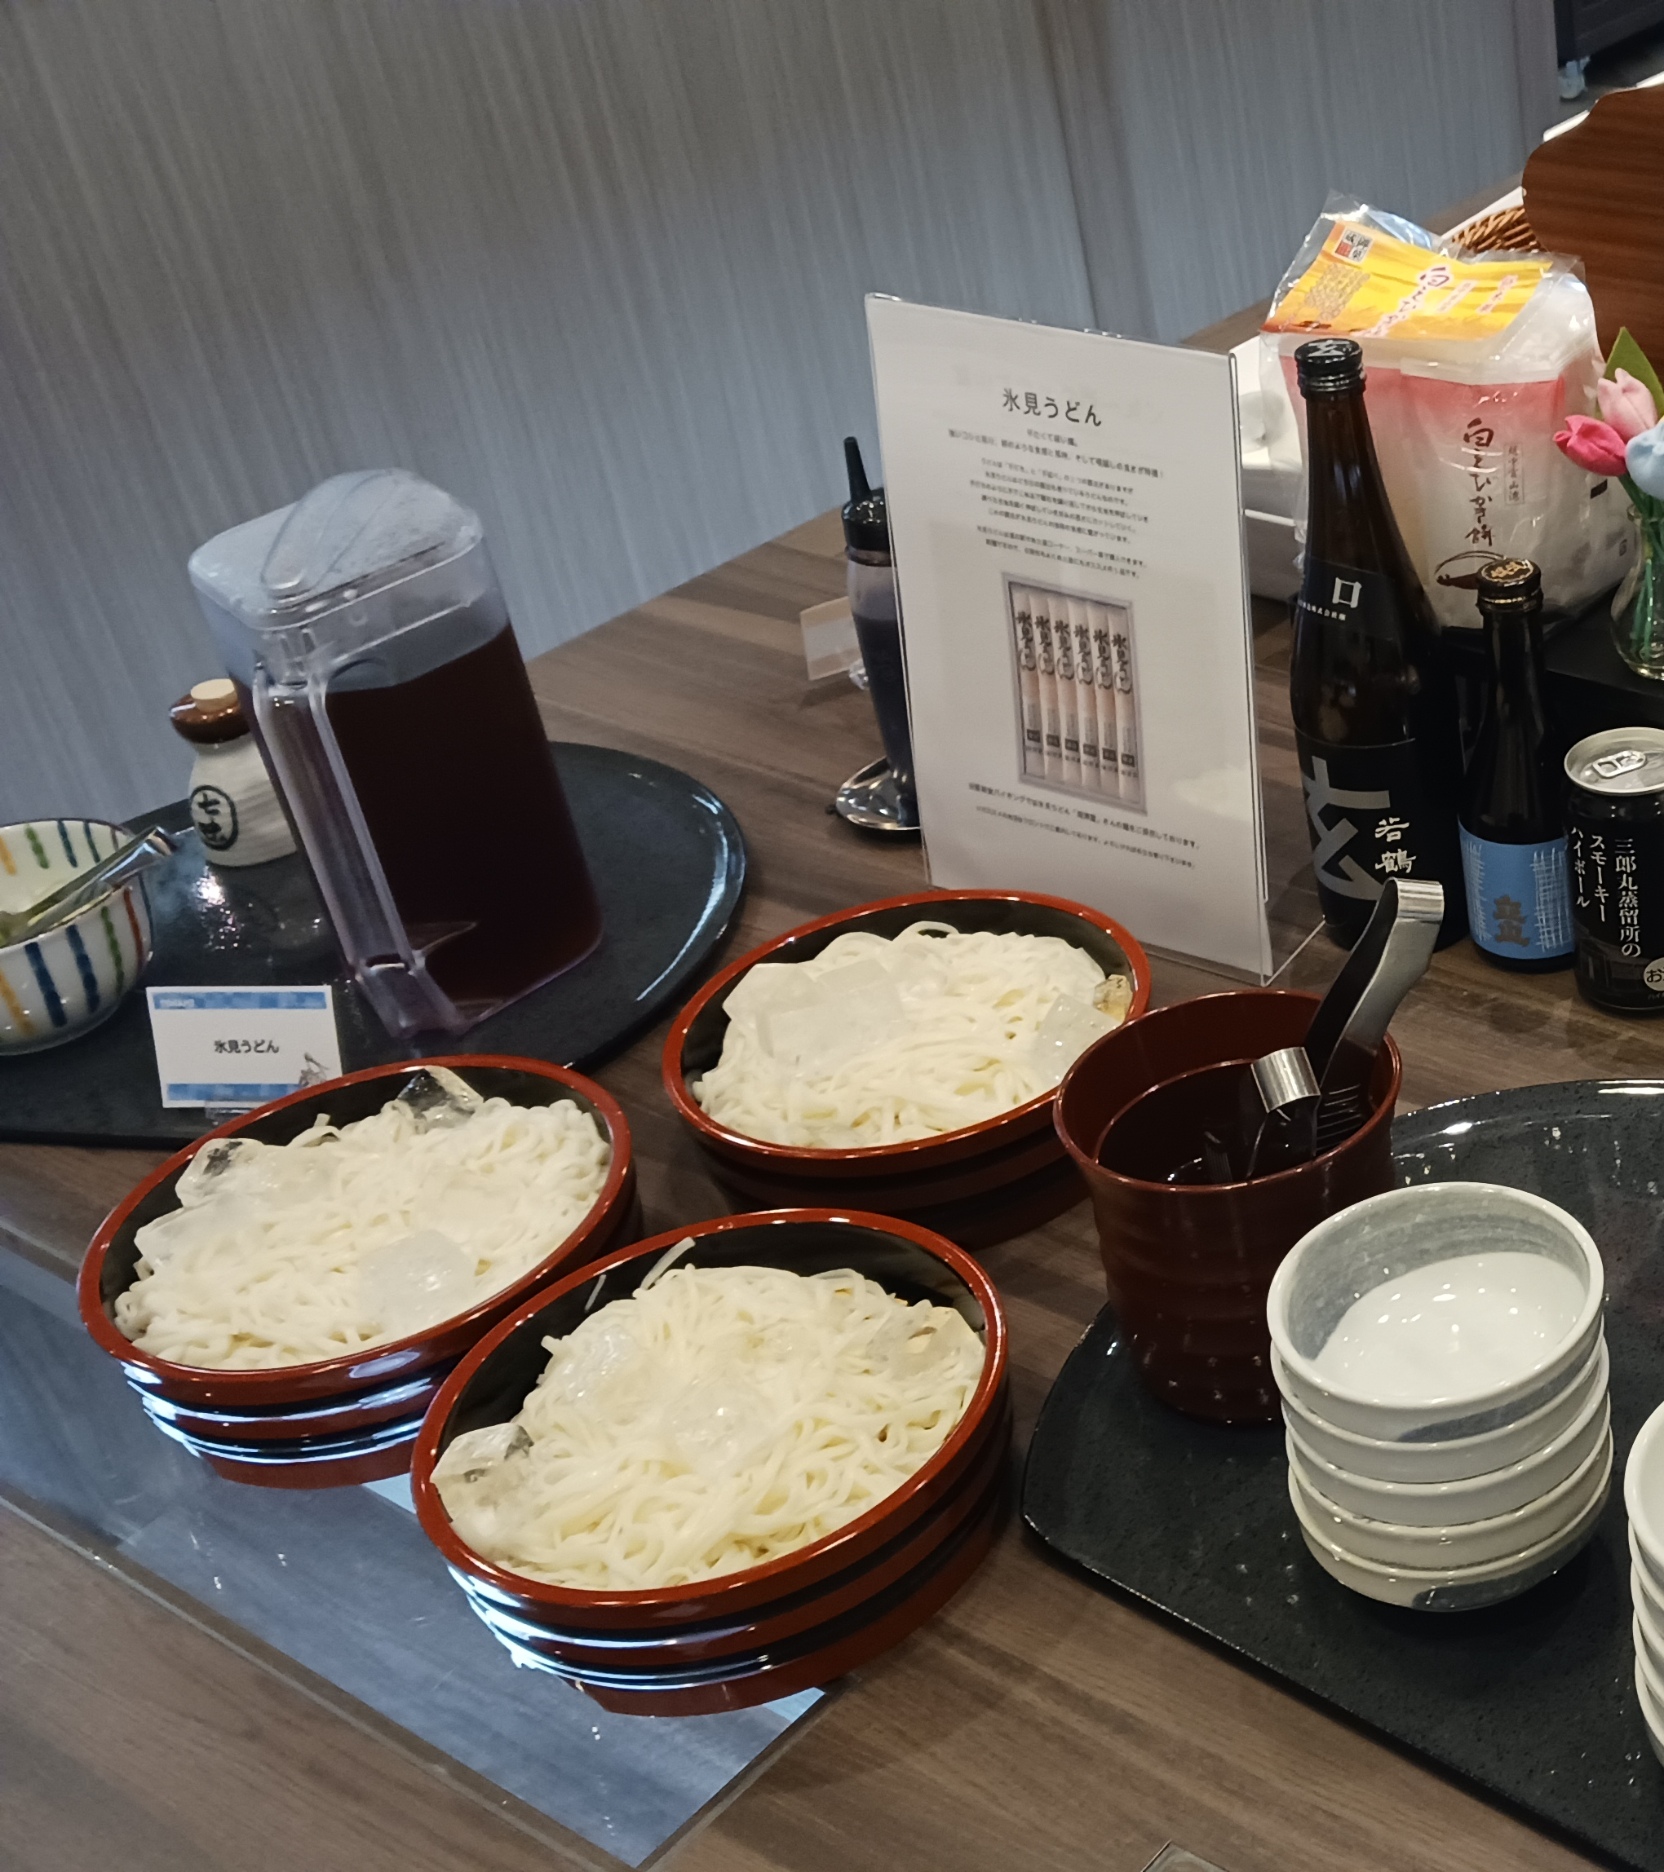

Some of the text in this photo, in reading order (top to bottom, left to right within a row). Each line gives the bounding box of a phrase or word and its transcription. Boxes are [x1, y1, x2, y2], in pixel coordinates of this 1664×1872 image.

[1001, 387, 1102, 427] 氷見うどん
[1375, 817, 1417, 875] 若鶴
[1571, 826, 1591, 908] ハイボール
[1590, 834, 1610, 923] スモーキー
[1615, 838, 1642, 958] 三郎丸蒸留所の
[213, 1038, 280, 1056] 氷見うどん
